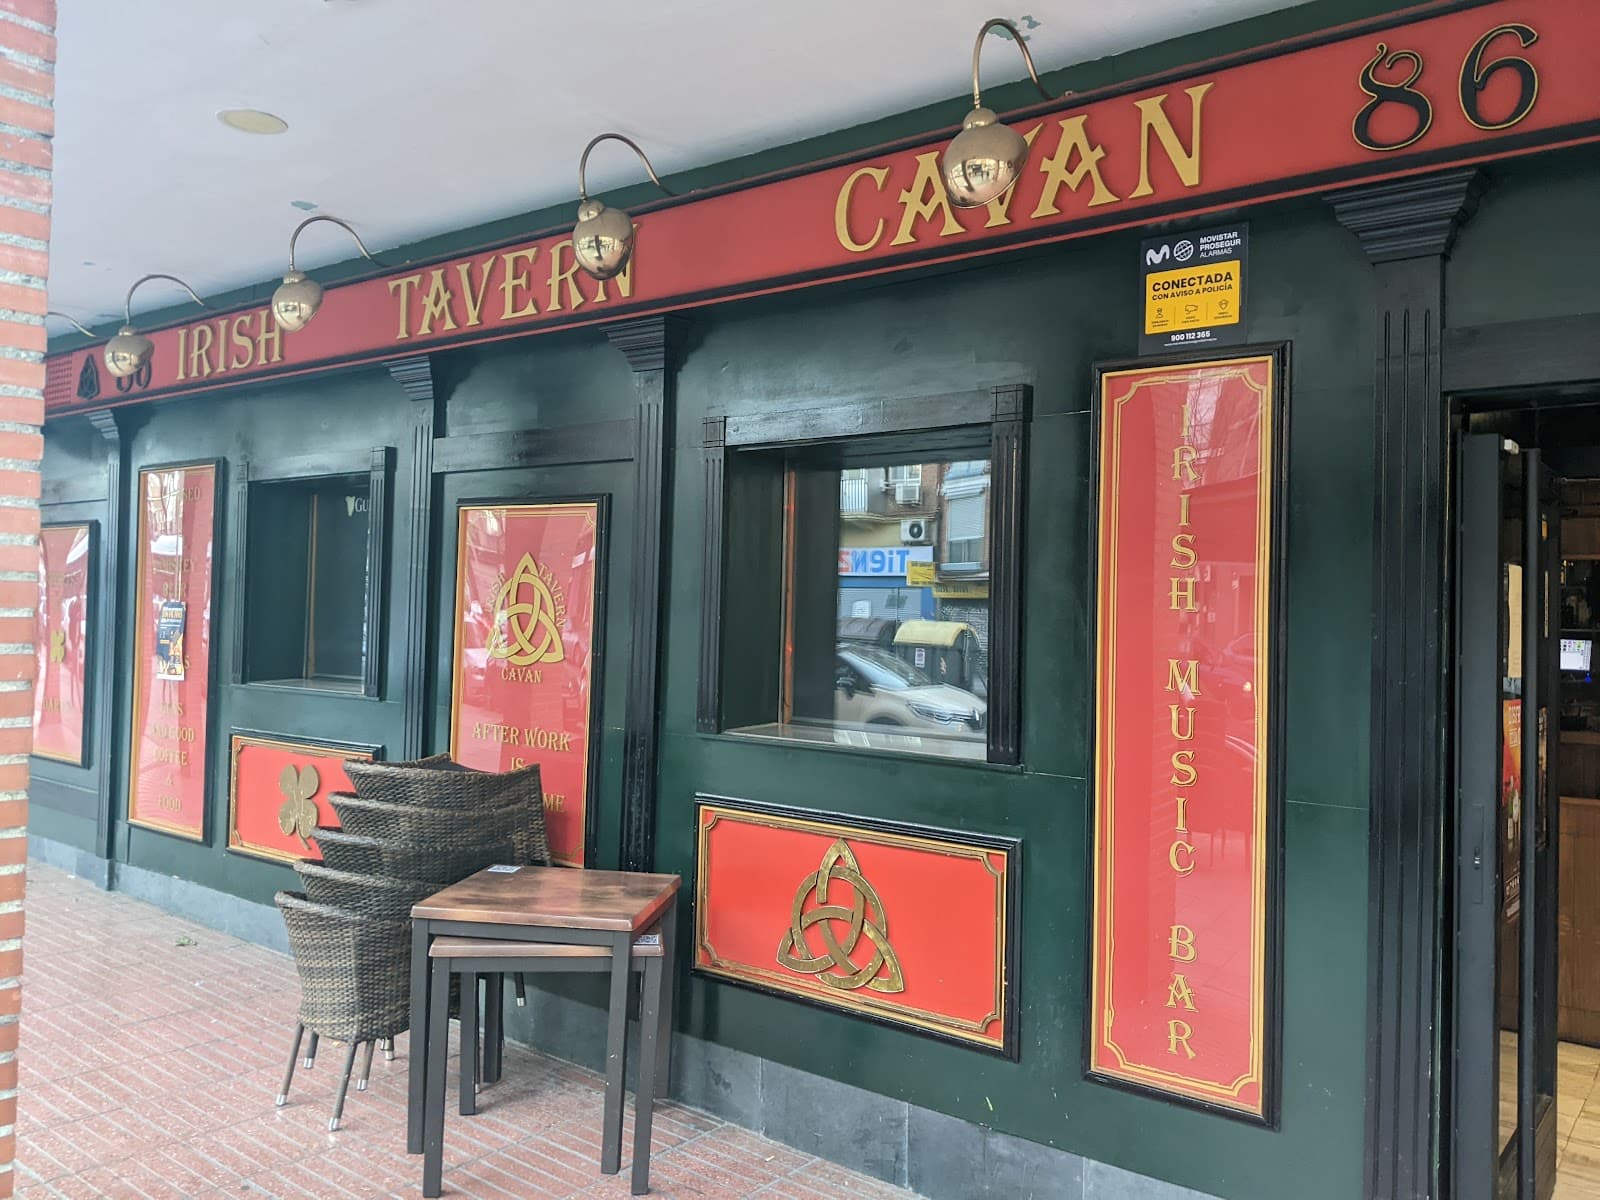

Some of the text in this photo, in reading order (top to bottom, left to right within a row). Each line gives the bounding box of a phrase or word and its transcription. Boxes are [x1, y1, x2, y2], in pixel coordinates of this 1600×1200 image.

[176, 309, 284, 381] IRISH
[1352, 22, 1539, 151] 86
[1199, 231, 1238, 244] MOVISTAR
[1199, 238, 1241, 252] PROSEGUR
[1199, 247, 1233, 258] ALARMAS
[1152, 271, 1233, 292] CONECTADA
[1152, 283, 1233, 301] CON AVISO A POLICÍA
[1170, 333, 1185, 342] 900
[1185, 332, 1196, 340] 112
[539, 562, 568, 628] TAVERN
[501, 667, 542, 684] CAVAN
[472, 721, 572, 752] AFTER WORK
[1164, 404, 1201, 1060] IRISH MUSIC BAR
